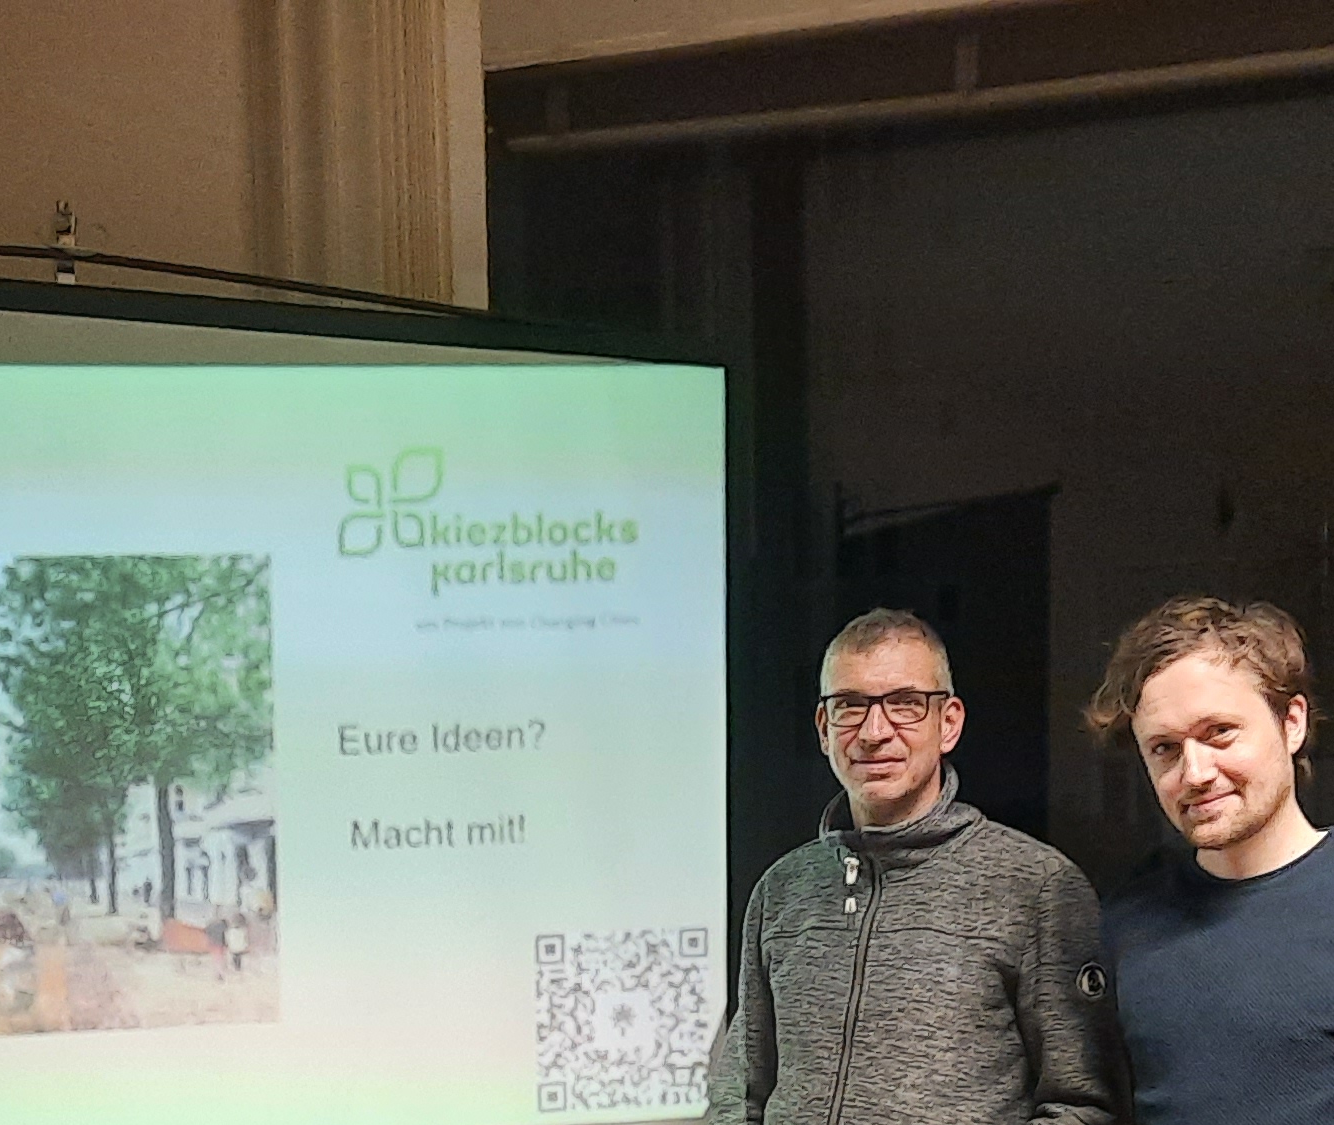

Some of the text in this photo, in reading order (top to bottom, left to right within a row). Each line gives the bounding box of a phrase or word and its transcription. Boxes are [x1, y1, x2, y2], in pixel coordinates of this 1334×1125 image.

[431, 510, 638, 545] kiezblocks
[431, 549, 616, 597] karlsruhe
[337, 718, 546, 756] Eure Ideen?
[350, 813, 526, 850] Macht mit!
